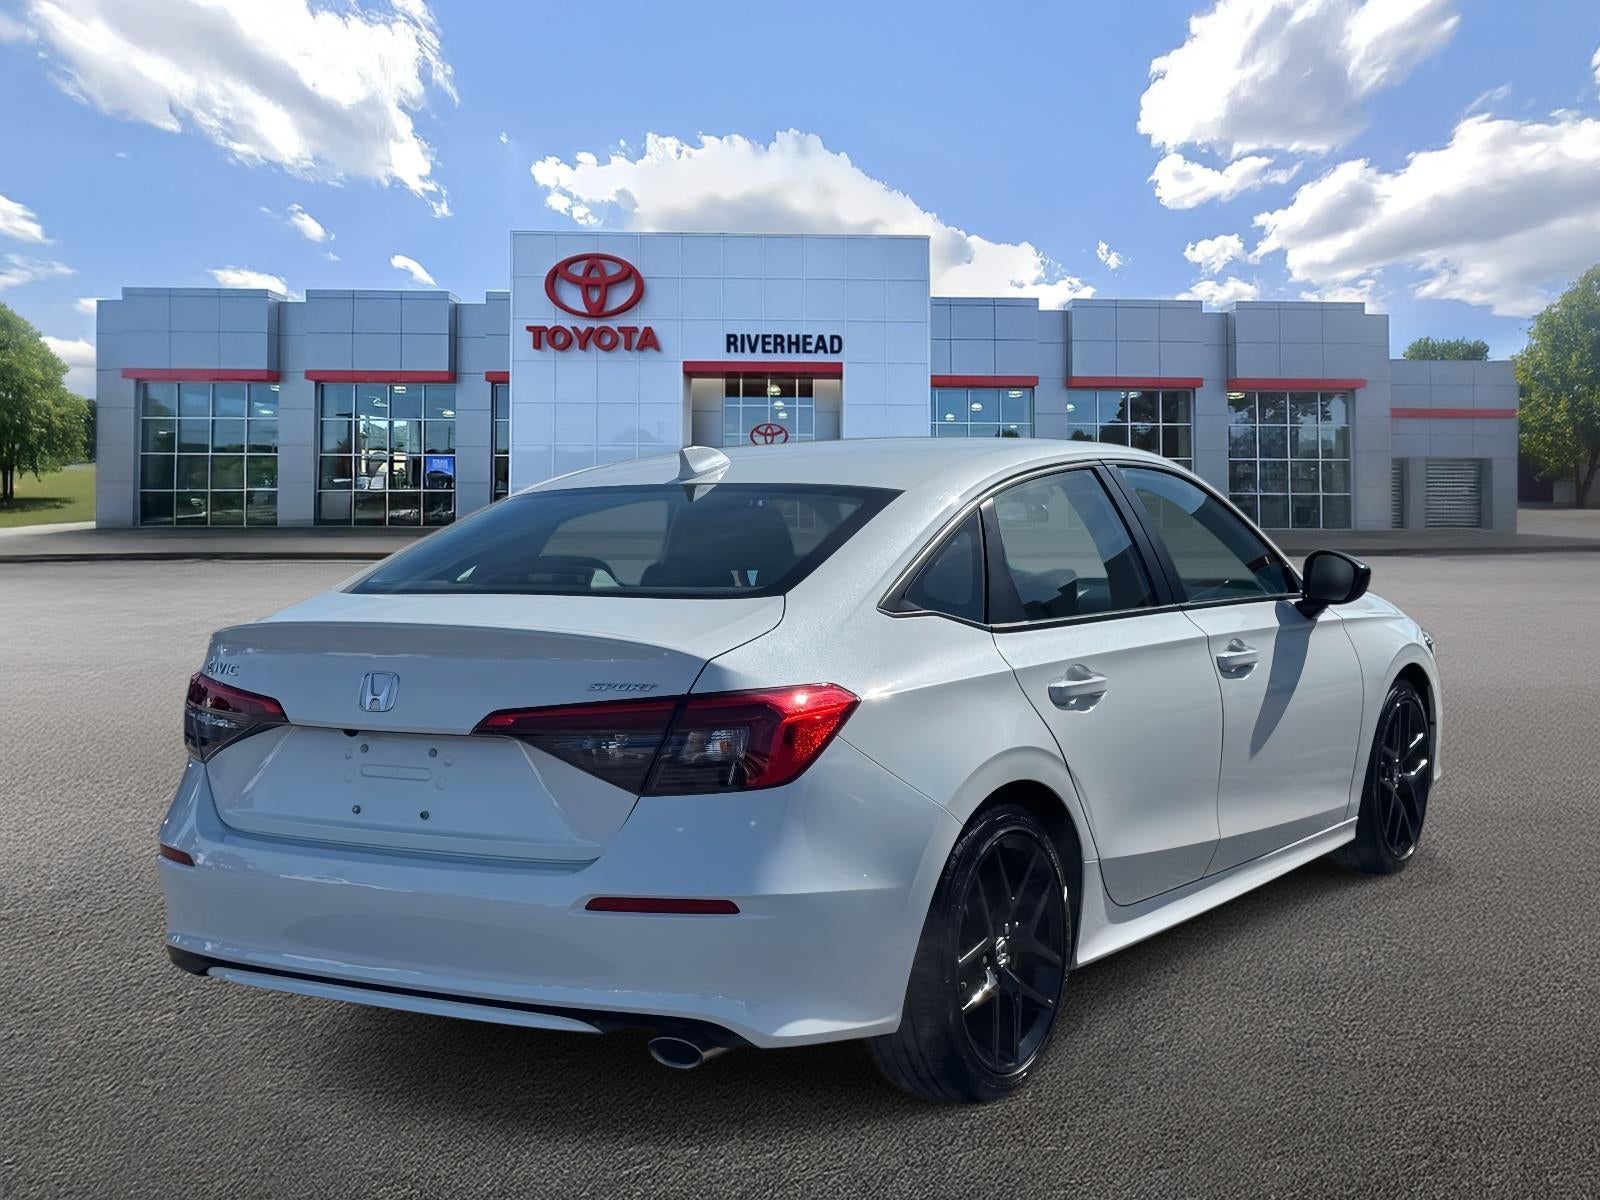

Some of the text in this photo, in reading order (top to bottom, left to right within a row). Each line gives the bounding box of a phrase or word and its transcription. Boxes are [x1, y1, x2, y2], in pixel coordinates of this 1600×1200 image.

[525, 325, 661, 352] TOYOTA
[725, 333, 843, 354] RIVERHEAD
[587, 682, 658, 692] SPORT
